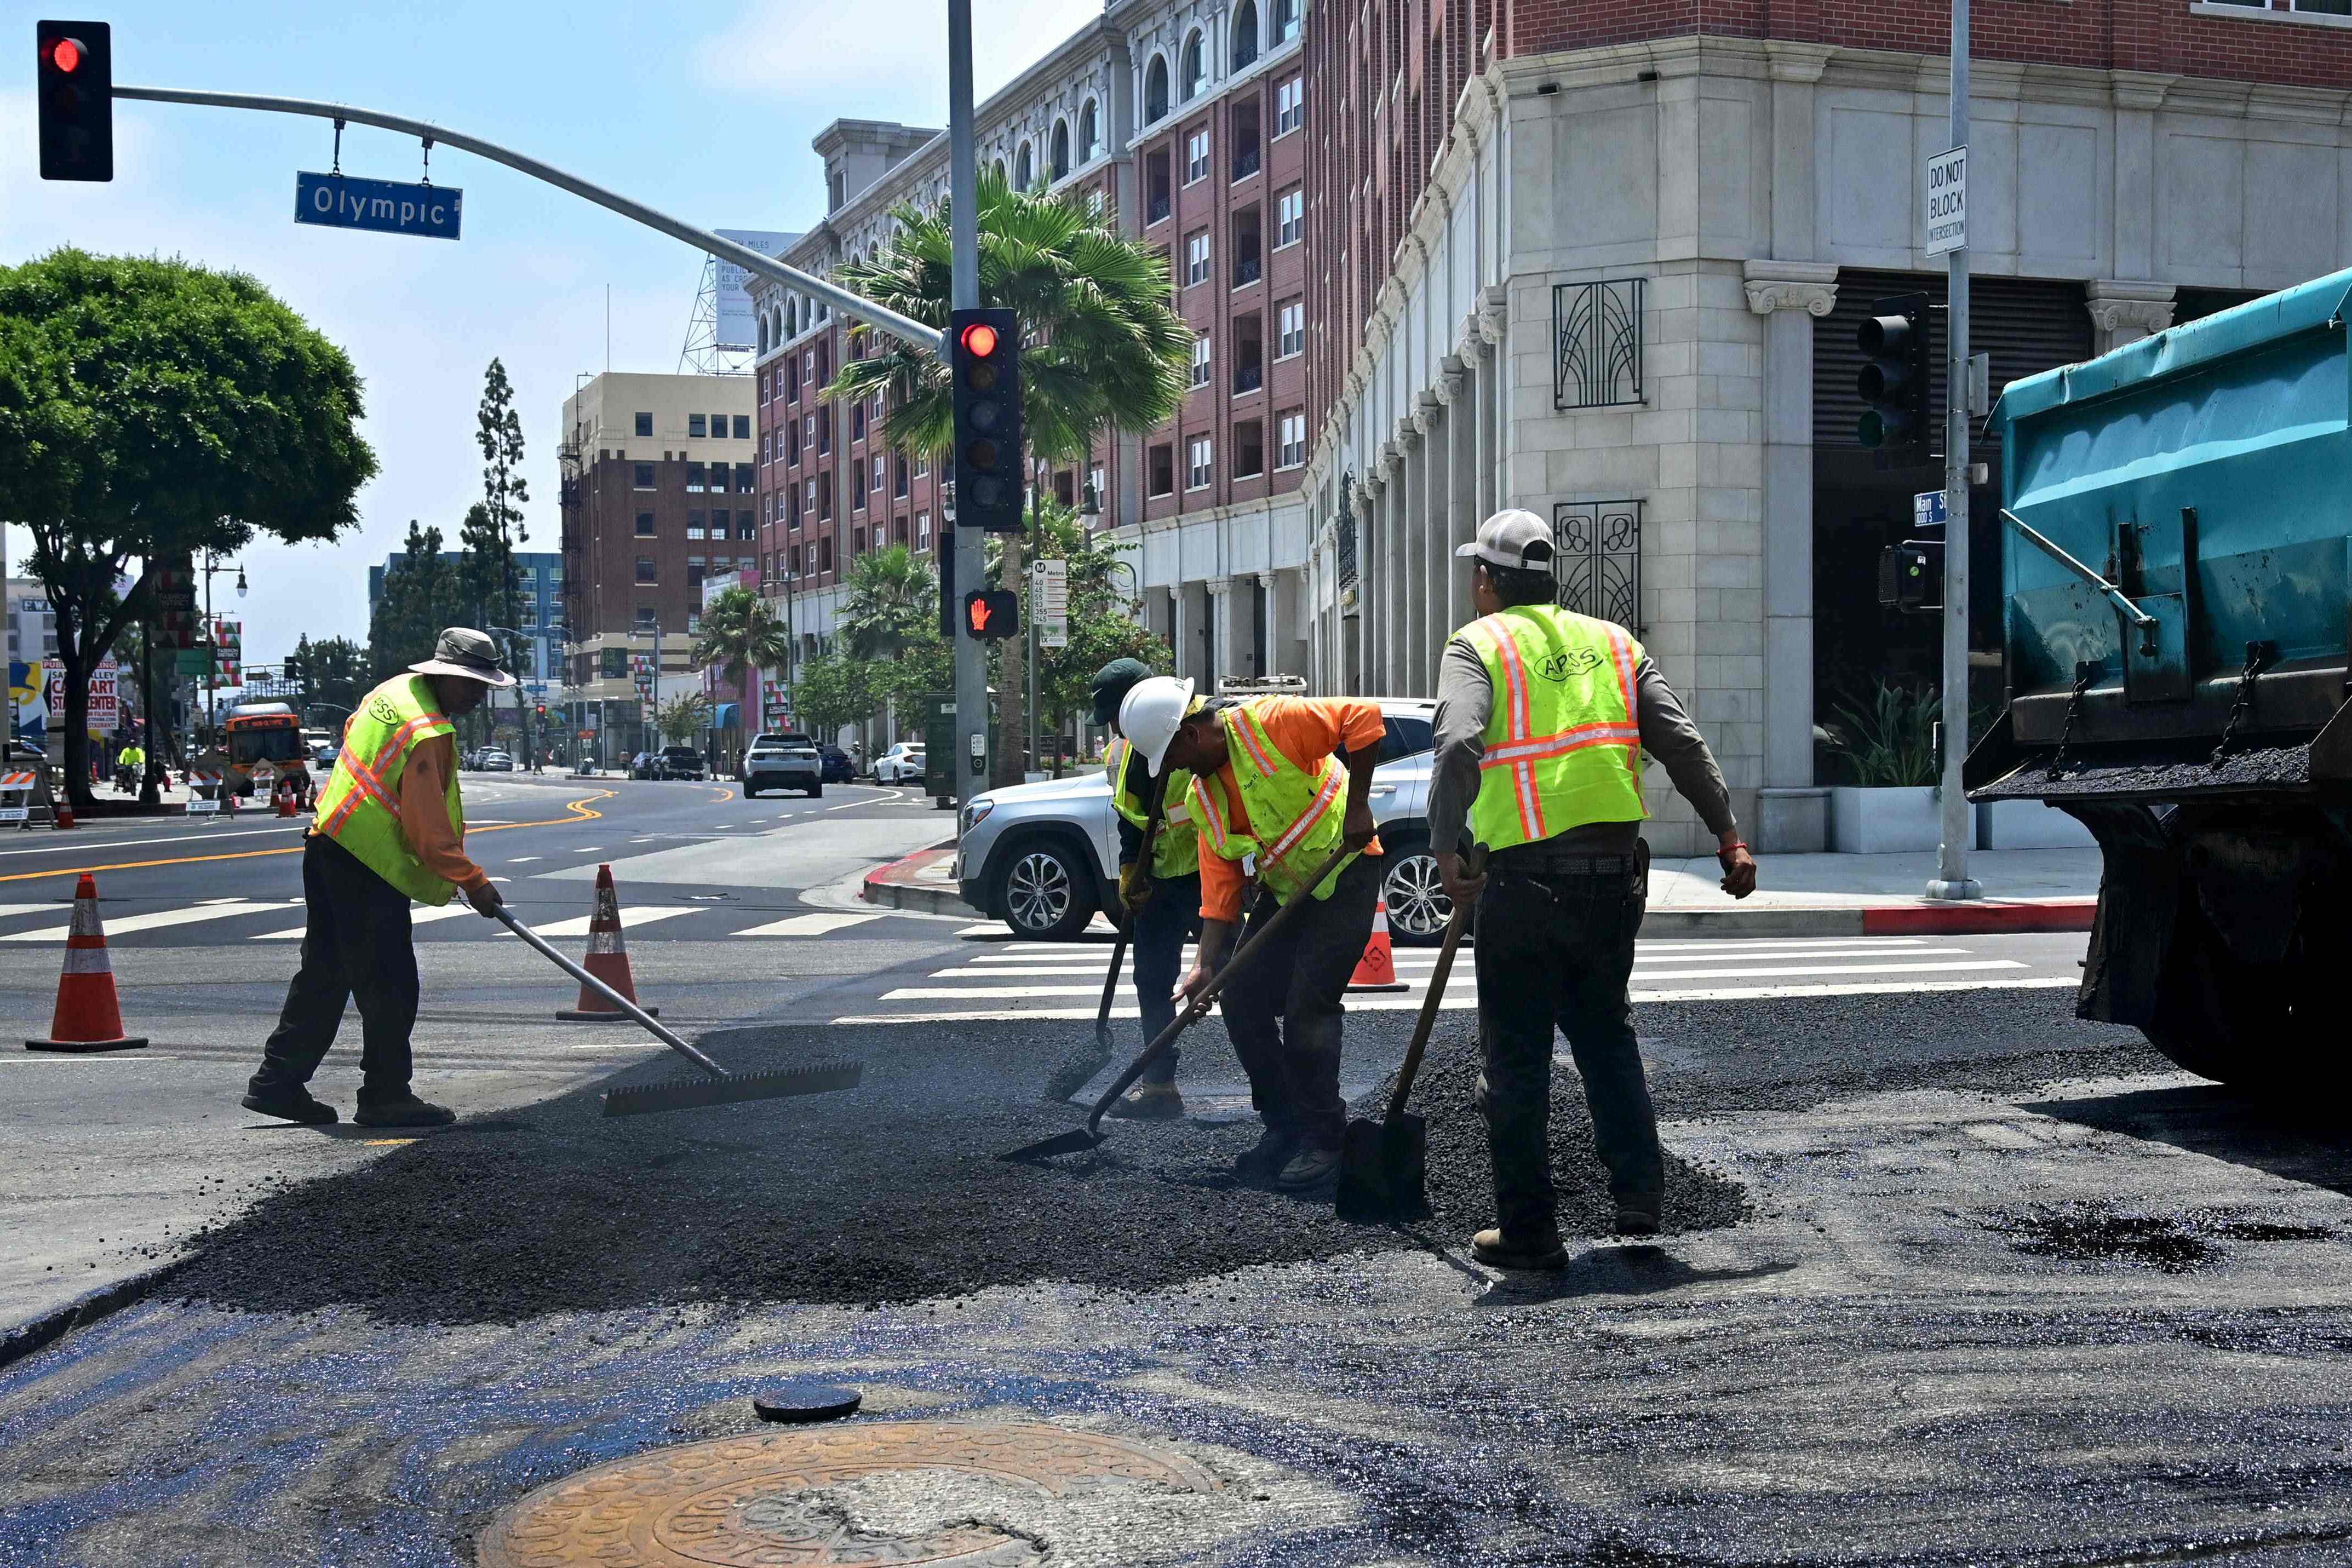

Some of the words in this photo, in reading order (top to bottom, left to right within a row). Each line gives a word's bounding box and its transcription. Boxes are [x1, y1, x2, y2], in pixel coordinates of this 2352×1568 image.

[1931, 166, 1943, 189] DO
[1946, 159, 1964, 187] NOT
[314, 186, 445, 225] Olympic
[1931, 189, 1964, 219] BLOCK
[1929, 220, 1964, 242] INTERSECTION
[1916, 497, 1931, 512] Main
[1917, 512, 1928, 524] 1000
[1929, 512, 1932, 522] S
[1545, 648, 1596, 675] APSS
